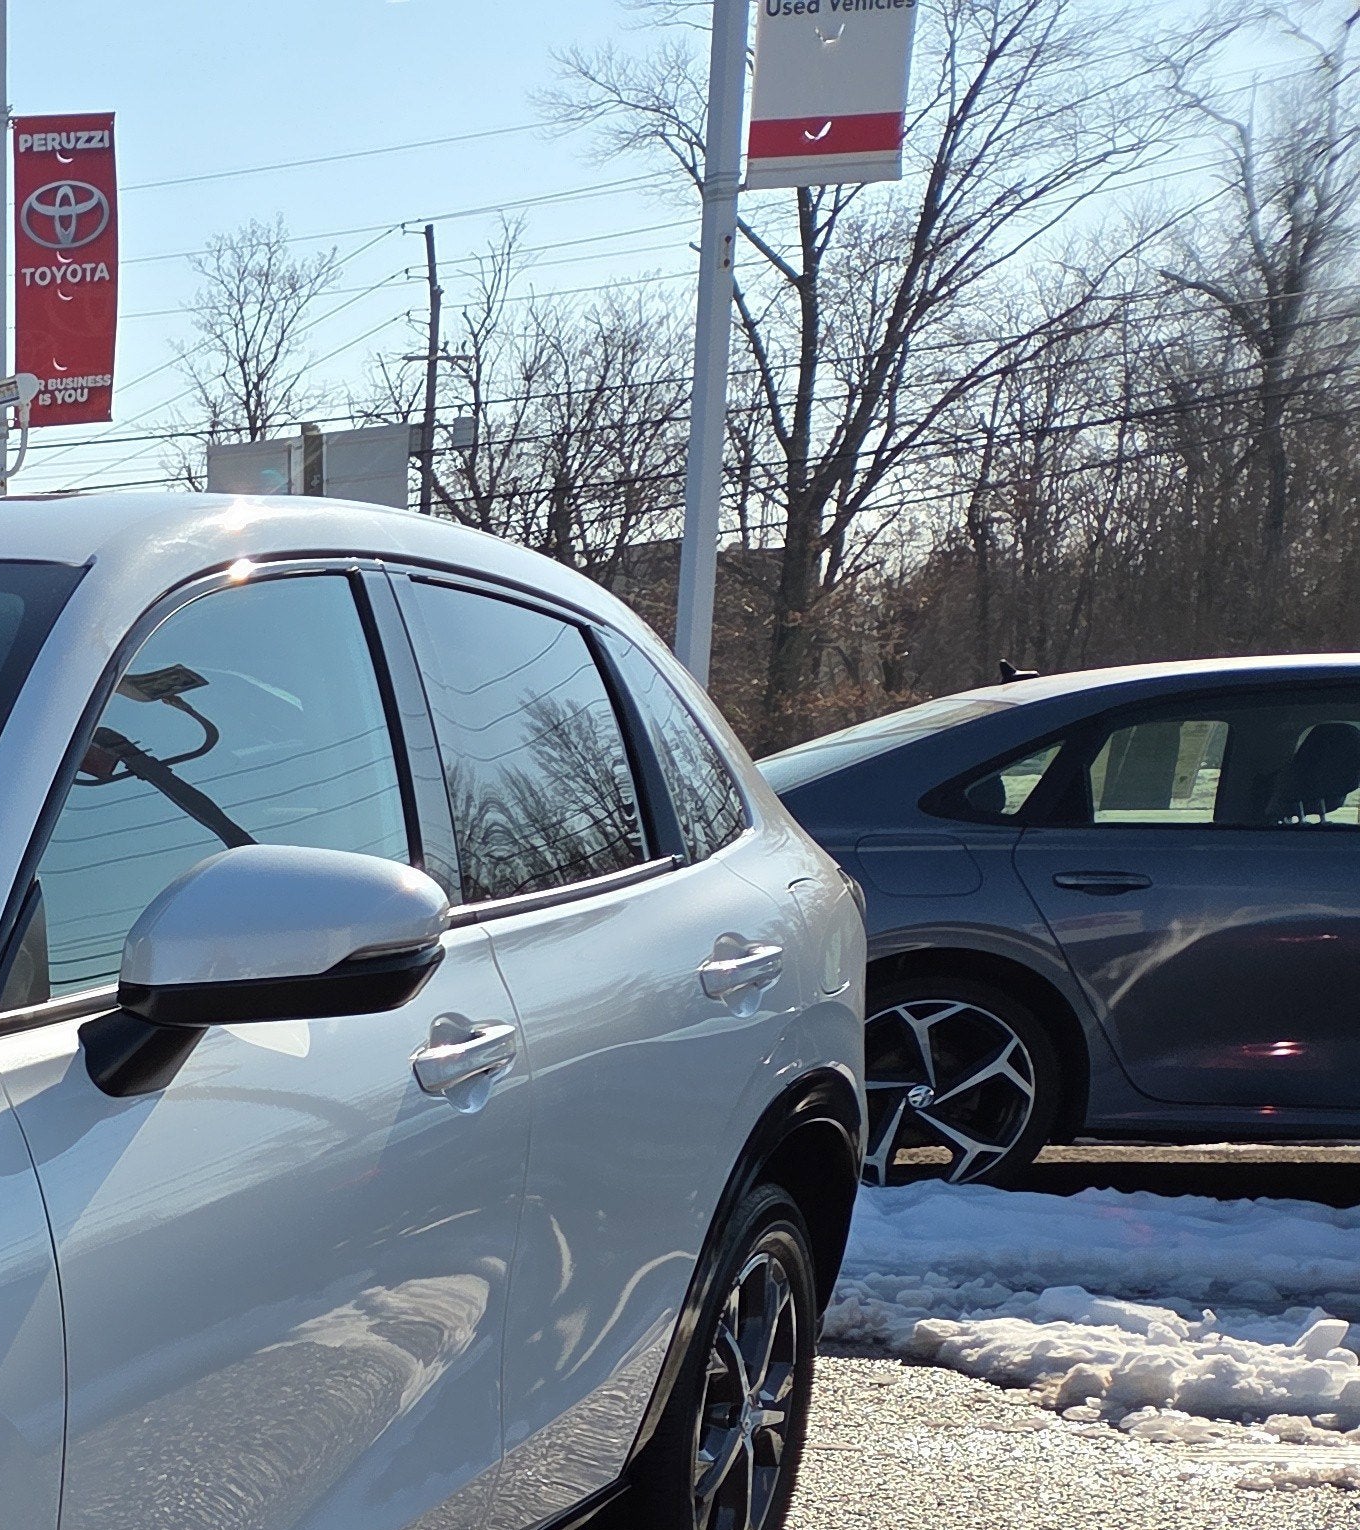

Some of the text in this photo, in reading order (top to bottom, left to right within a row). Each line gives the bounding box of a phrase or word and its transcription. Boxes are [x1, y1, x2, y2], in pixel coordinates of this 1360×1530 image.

[766, 0, 820, 17] Used
[18, 130, 110, 153] PERUZZI
[21, 262, 110, 287] TOYOTA
[47, 374, 111, 390] BUSINESS
[38, 388, 89, 405] IS YOU
